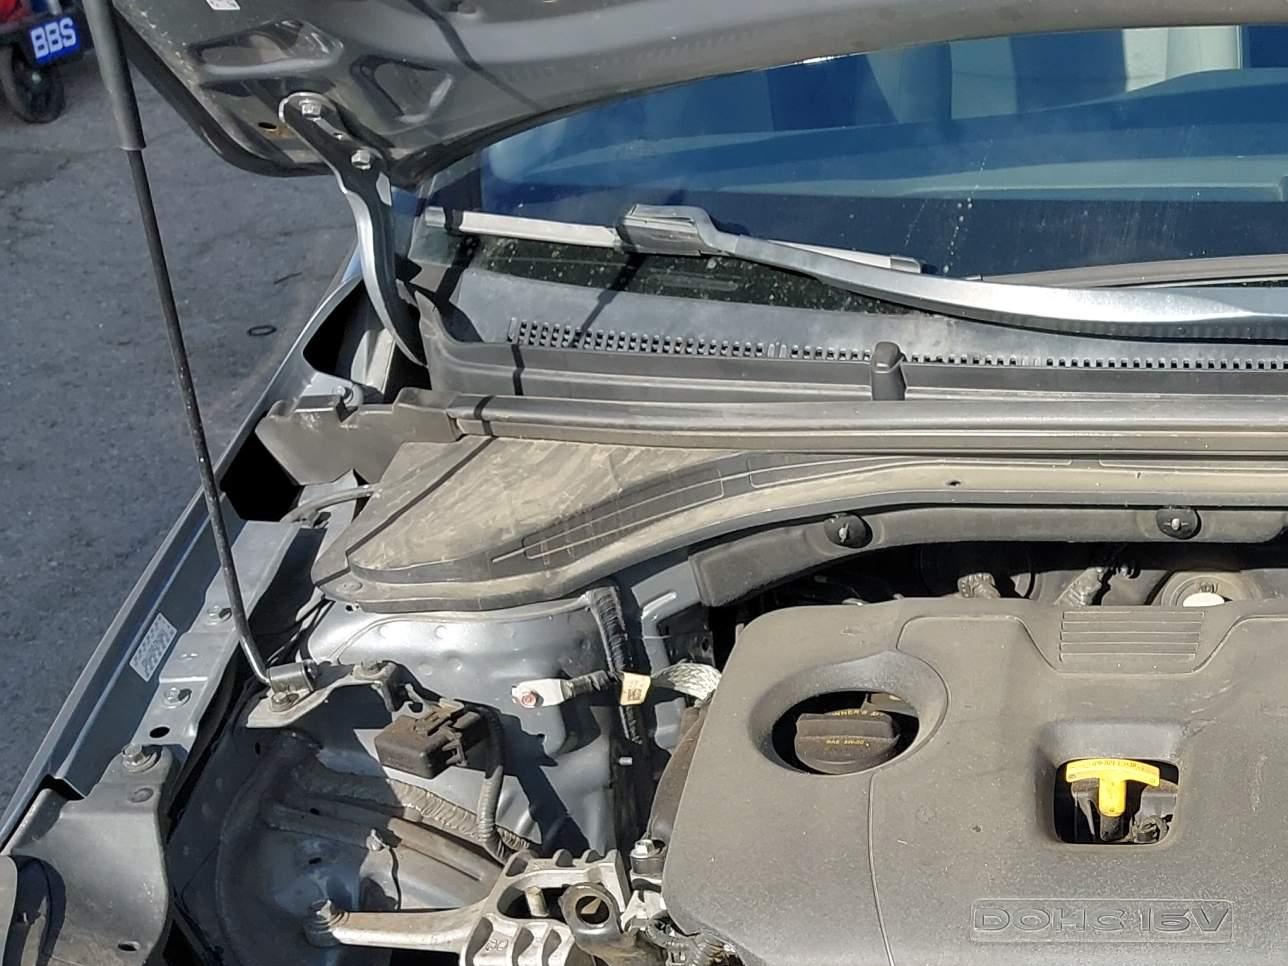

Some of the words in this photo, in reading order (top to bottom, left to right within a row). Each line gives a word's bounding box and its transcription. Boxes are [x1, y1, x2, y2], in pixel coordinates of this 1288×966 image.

[31, 17, 76, 59] BBS
[974, 907, 1126, 933] DOHC
[1138, 907, 1230, 933] 16V
